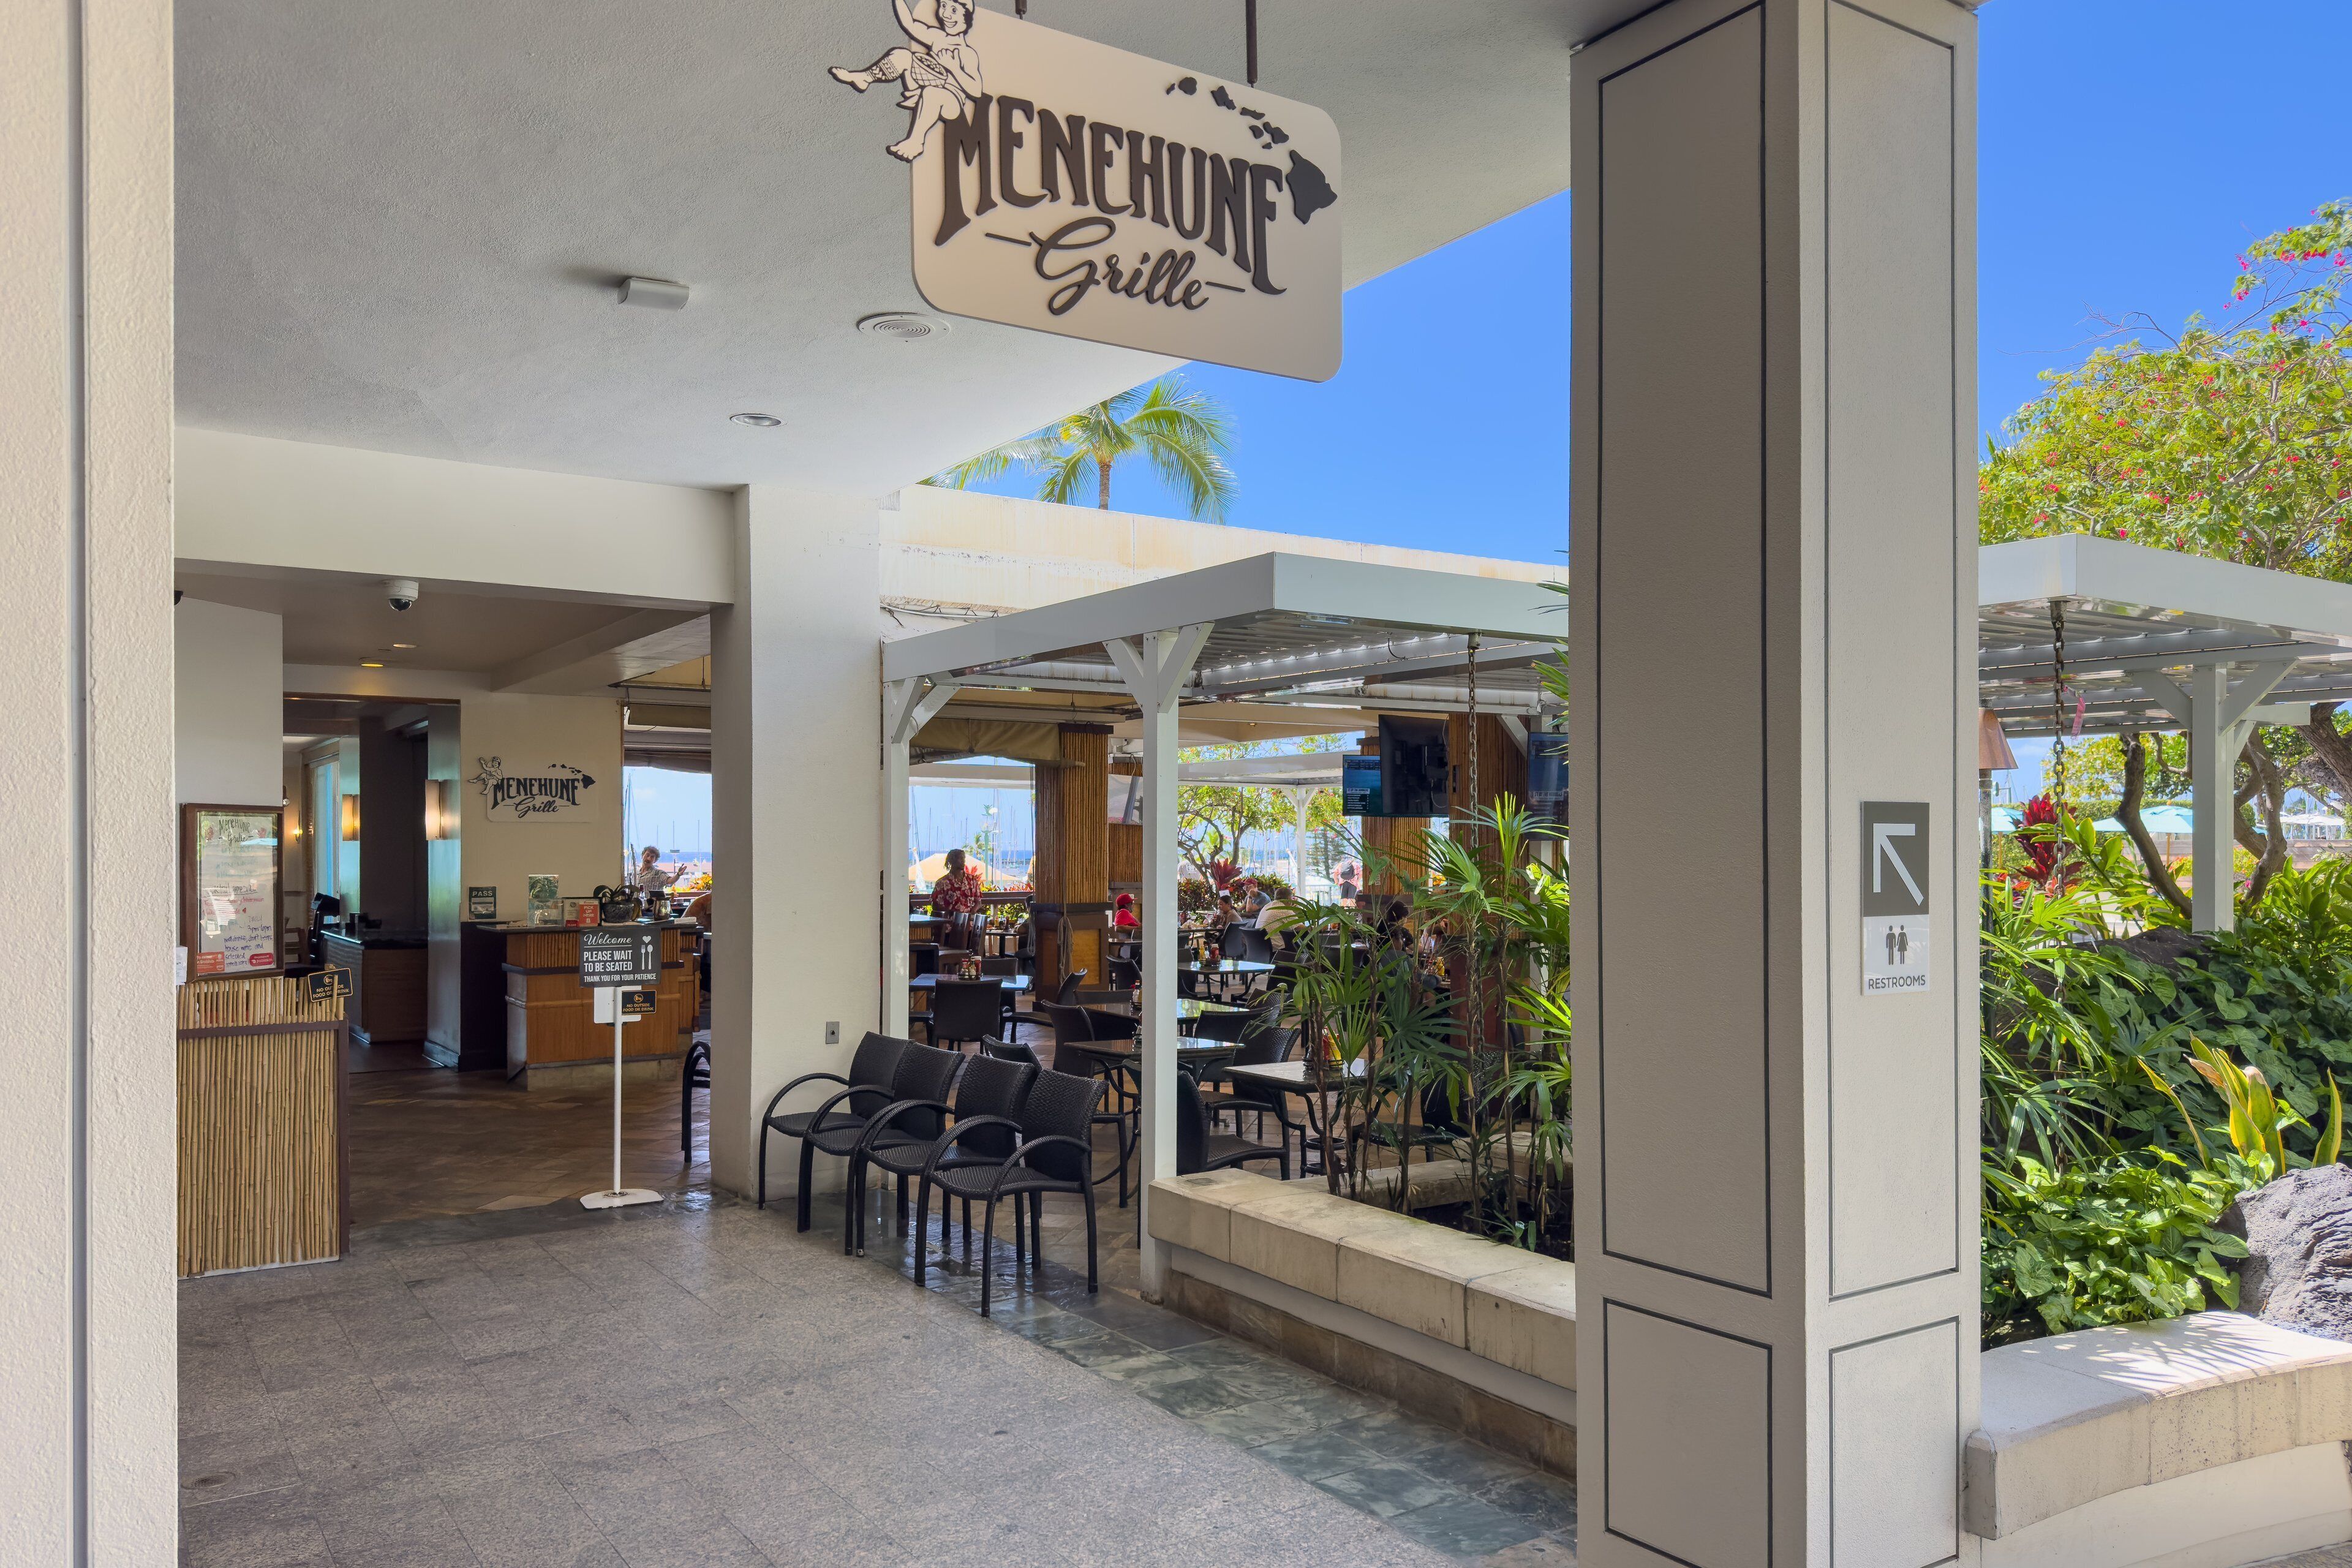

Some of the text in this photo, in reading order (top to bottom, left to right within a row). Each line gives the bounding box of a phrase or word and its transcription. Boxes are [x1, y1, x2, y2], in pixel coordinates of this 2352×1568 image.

[935, 93, 1288, 296] MENEHUNE
[1029, 216, 1210, 316] Grille
[491, 777, 581, 810] MENEHUNE
[514, 797, 560, 819] Grille
[584, 932, 633, 945] Welcome
[584, 950, 633, 962] PLEASE WAIT
[584, 962, 633, 972] TO BE SEATED
[1868, 974, 1926, 990] RESTROOMS
